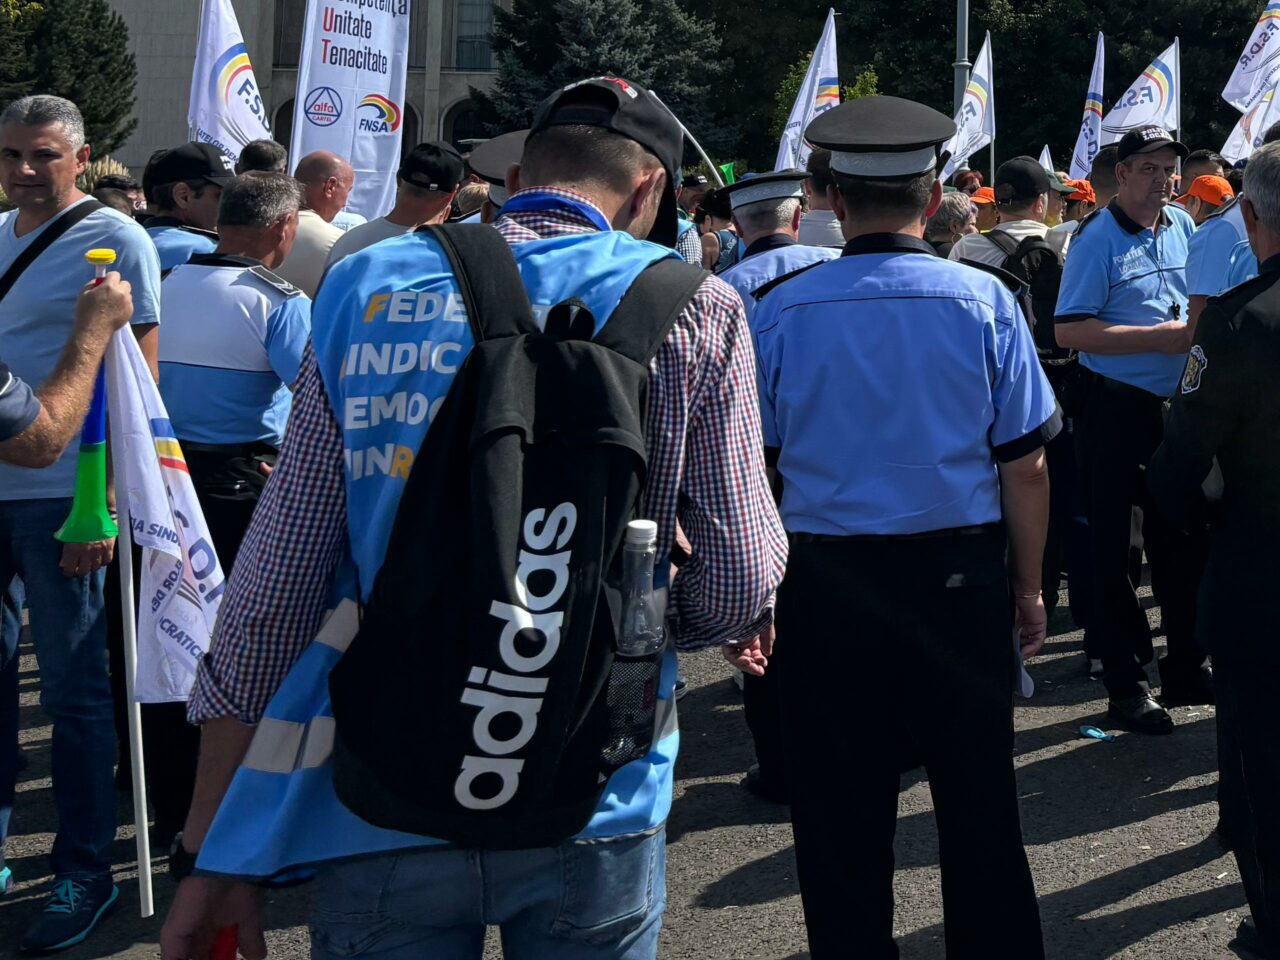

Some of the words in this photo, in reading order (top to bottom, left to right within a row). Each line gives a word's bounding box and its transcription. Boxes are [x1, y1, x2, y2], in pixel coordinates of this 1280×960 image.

[323, 6, 372, 39] Unitate
[321, 38, 388, 75] Tenacitate
[312, 115, 333, 123] CARTEL
[313, 102, 334, 114] alfa
[358, 118, 389, 133] FNSA
[339, 341, 462, 380] INDIC
[454, 501, 578, 811] adidas
